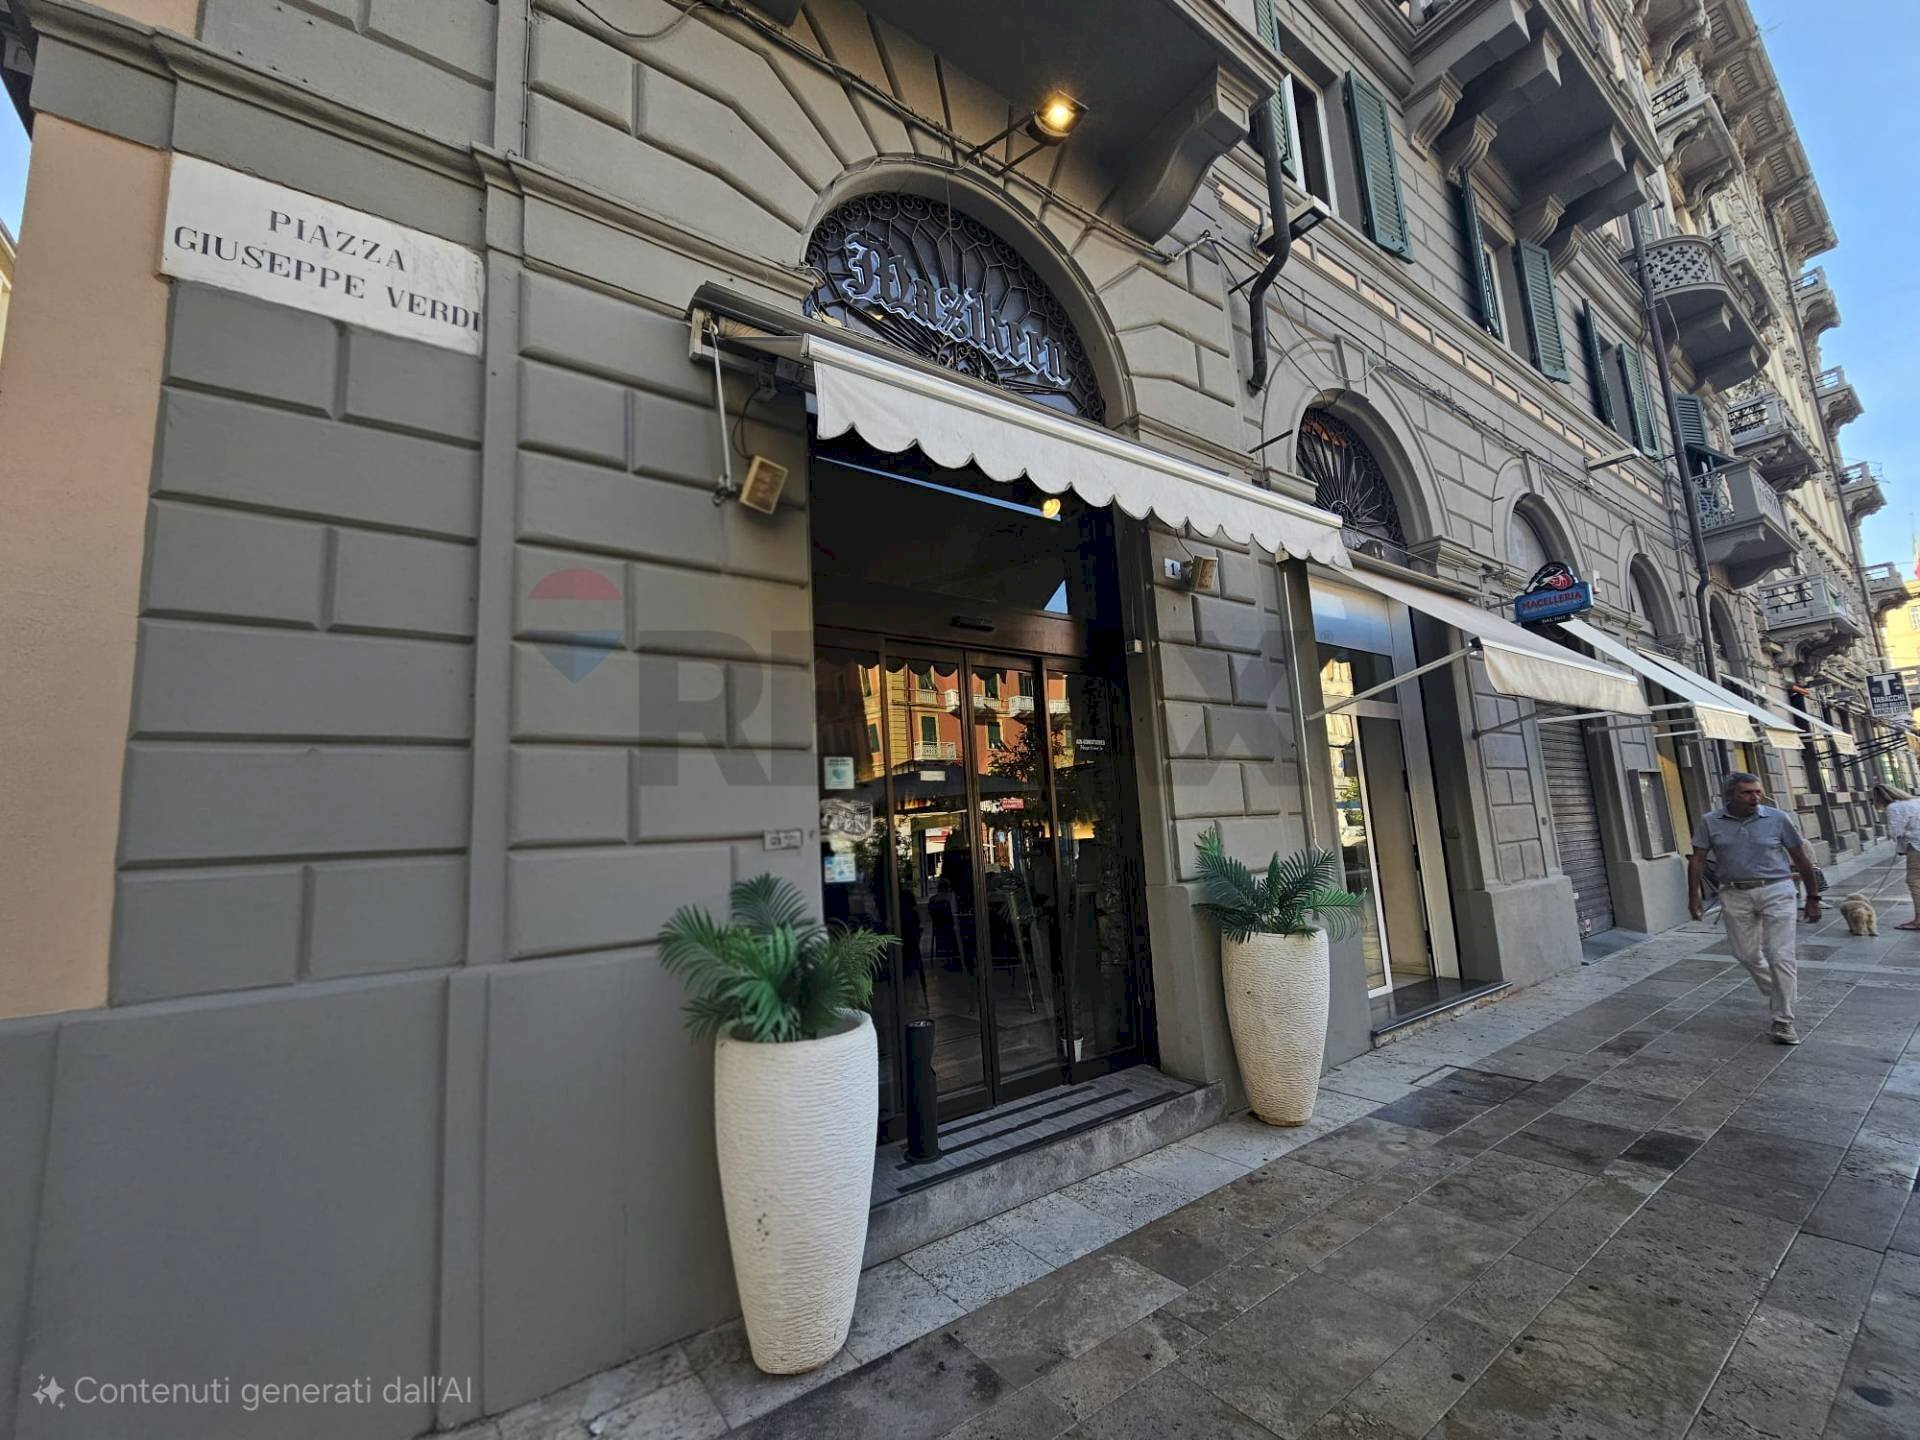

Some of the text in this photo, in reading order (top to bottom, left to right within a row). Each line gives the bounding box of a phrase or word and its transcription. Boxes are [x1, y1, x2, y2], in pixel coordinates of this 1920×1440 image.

[268, 209, 406, 272] PIAZZA
[174, 226, 481, 333] GIUSEPPE VERDI
[1522, 591, 1582, 610] MACELLERIA
[1873, 674, 1897, 696] T
[1872, 694, 1905, 703] TABACCHI
